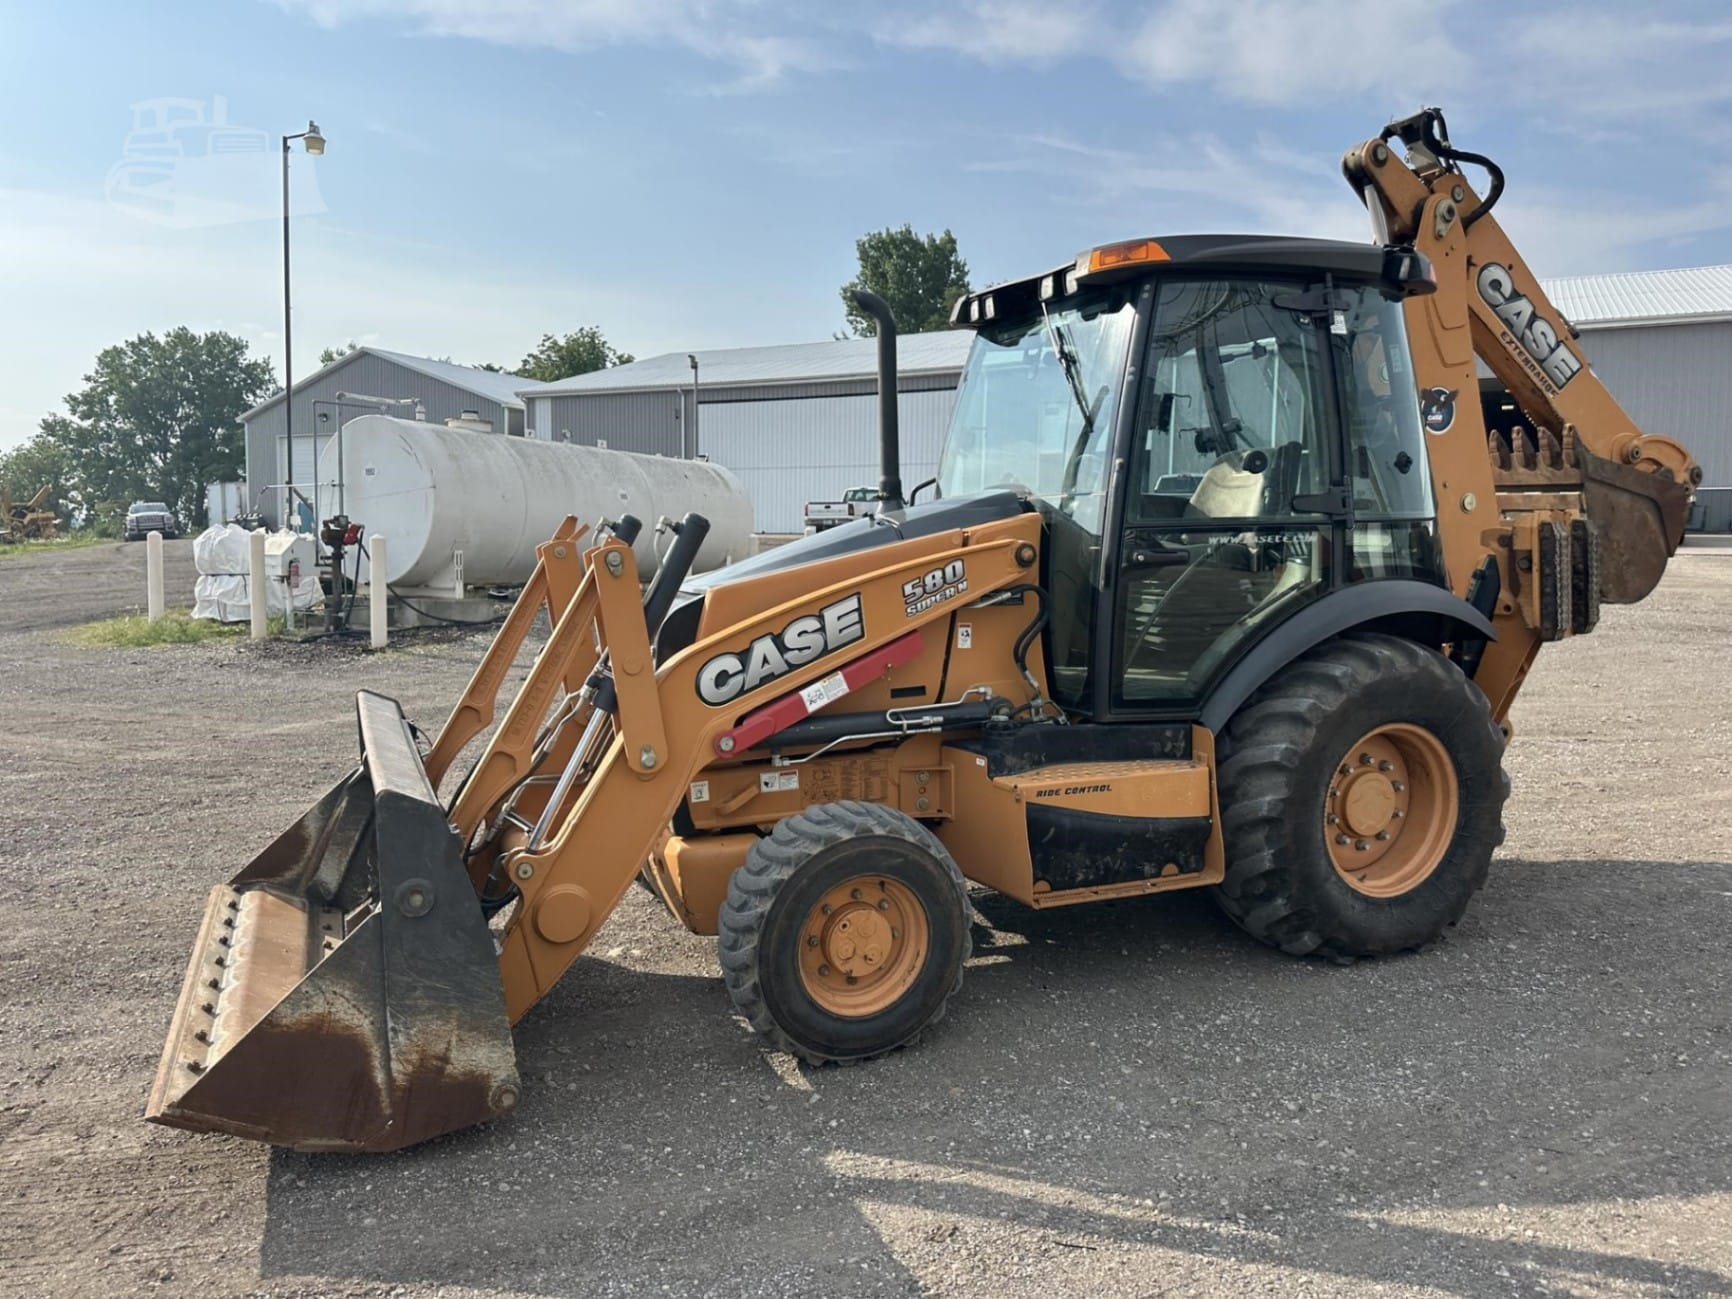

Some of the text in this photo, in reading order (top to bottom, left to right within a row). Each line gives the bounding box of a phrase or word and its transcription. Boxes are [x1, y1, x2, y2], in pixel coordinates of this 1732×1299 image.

[1478, 263, 1582, 390] CASE
[902, 558, 965, 605] 580
[905, 580, 969, 617] SUPER N
[696, 592, 865, 706] CASE
[1036, 784, 1112, 798] RIDE CONTROL
